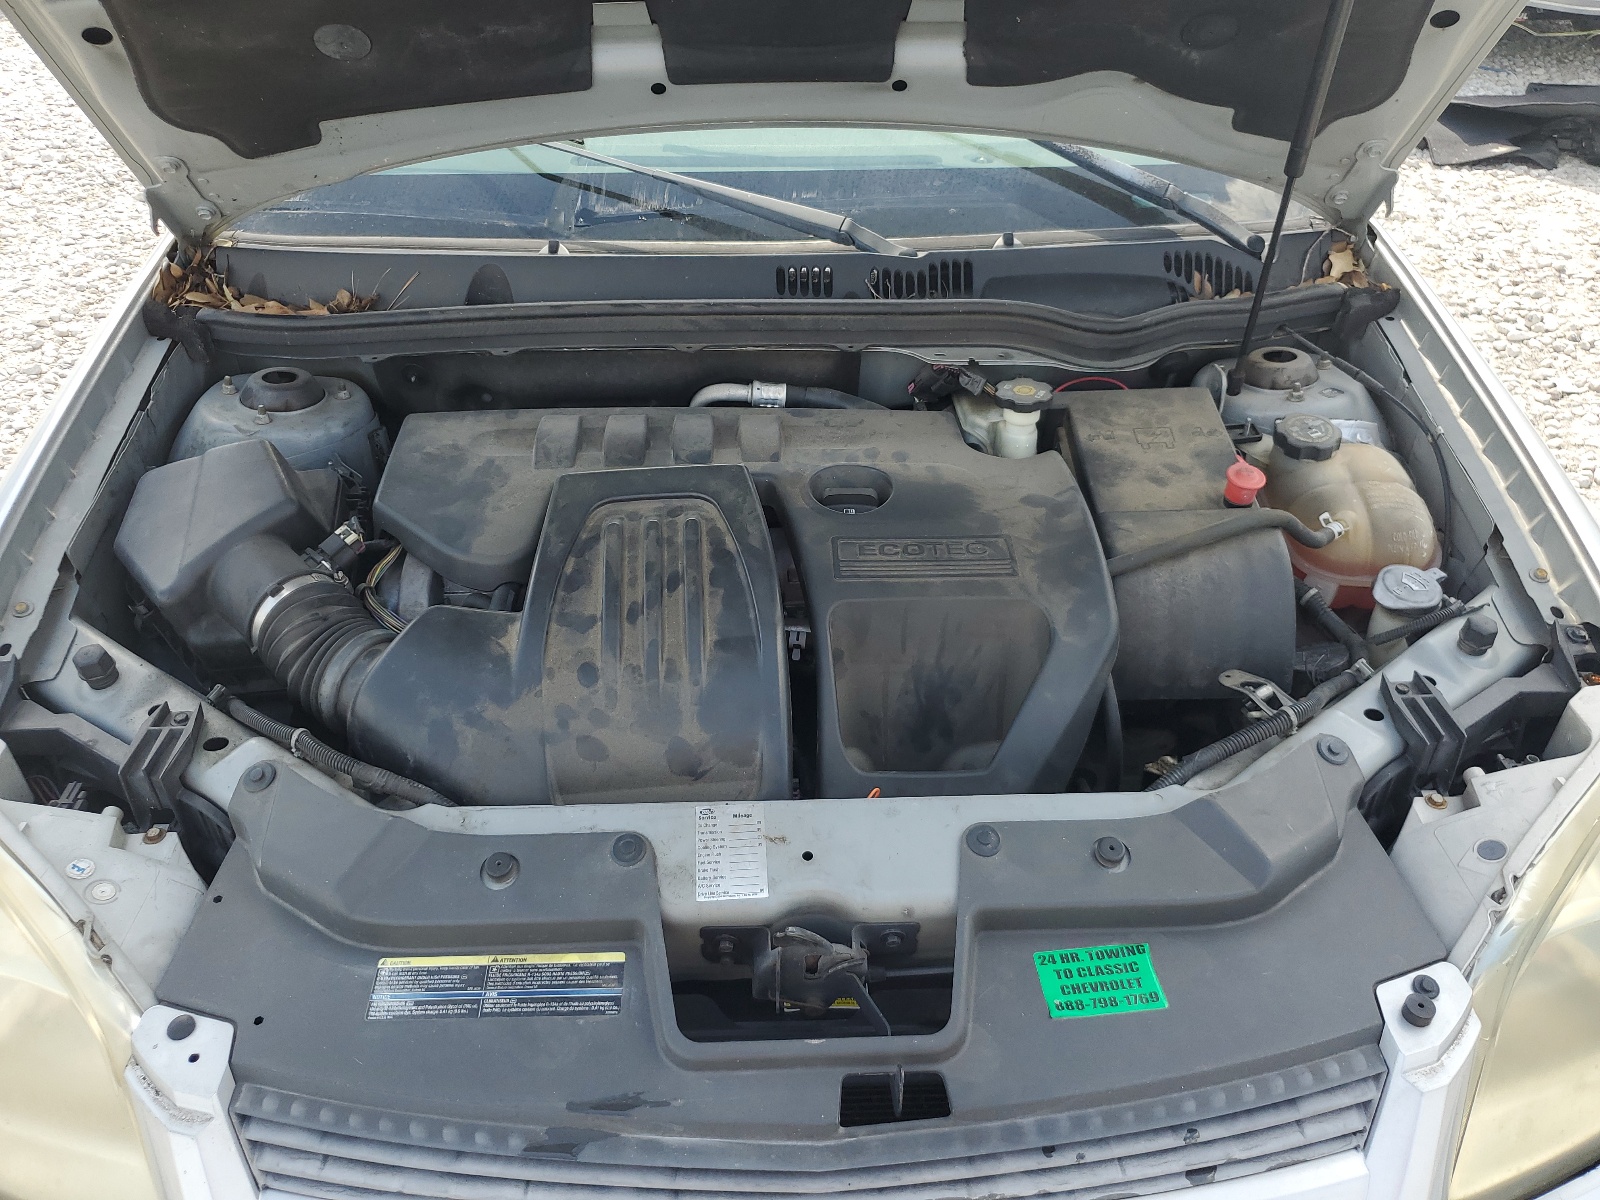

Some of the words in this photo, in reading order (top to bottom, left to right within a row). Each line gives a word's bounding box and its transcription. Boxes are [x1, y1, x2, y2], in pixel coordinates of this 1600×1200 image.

[857, 541, 988, 557] ECOTEC
[1038, 954, 1057, 966] 24
[1059, 952, 1085, 964] HR.
[1085, 944, 1147, 961] TOWING
[1053, 968, 1073, 980] TO
[1076, 961, 1140, 979] CLASSIC
[1060, 977, 1142, 996] CHEVROLET
[1055, 991, 1160, 1012] 888-798-1769
